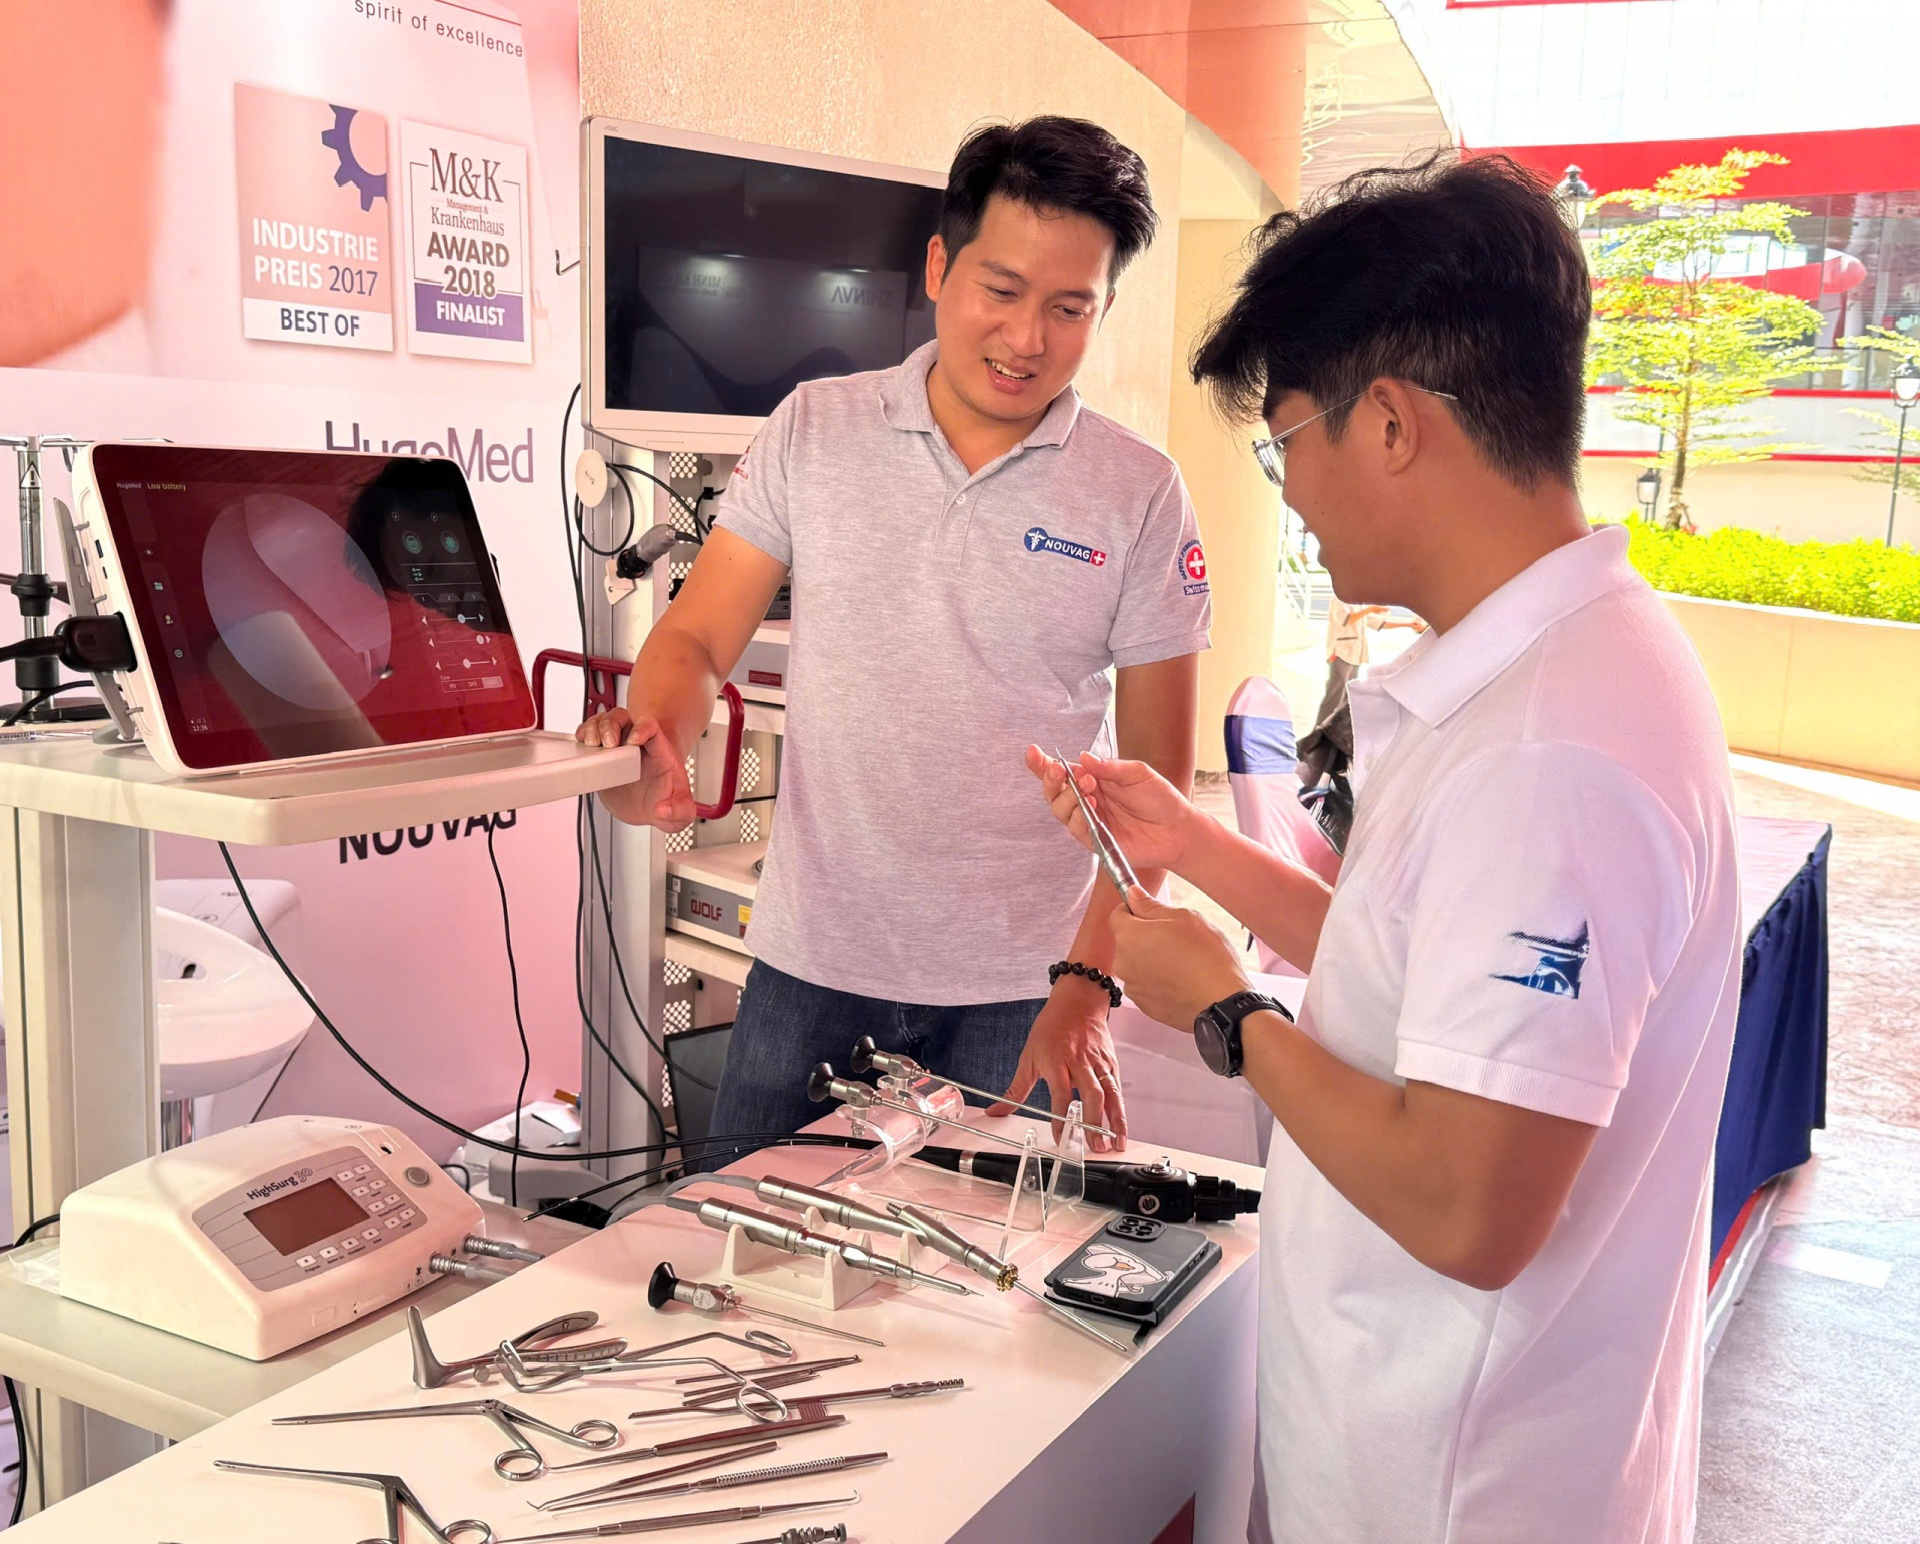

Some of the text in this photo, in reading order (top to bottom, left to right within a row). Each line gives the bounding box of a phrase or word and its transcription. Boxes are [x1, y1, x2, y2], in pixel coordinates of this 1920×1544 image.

[355, 0, 523, 57] spirit of excellence
[429, 147, 504, 203] M&K
[431, 207, 505, 236] Krankenhaus
[253, 217, 379, 262] INDUSTRIE
[427, 231, 510, 268] AWARD
[254, 255, 378, 296] PREIS 2017
[443, 265, 496, 297] 2018
[280, 307, 360, 337] BEST OF
[436, 300, 505, 326] FINALIST
[147, 482, 161, 490] Low
[162, 483, 187, 491] battery
[1044, 539, 1090, 560] NOUVAG
[690, 898, 722, 921] WOLF
[246, 1176, 299, 1200] HighSurg
